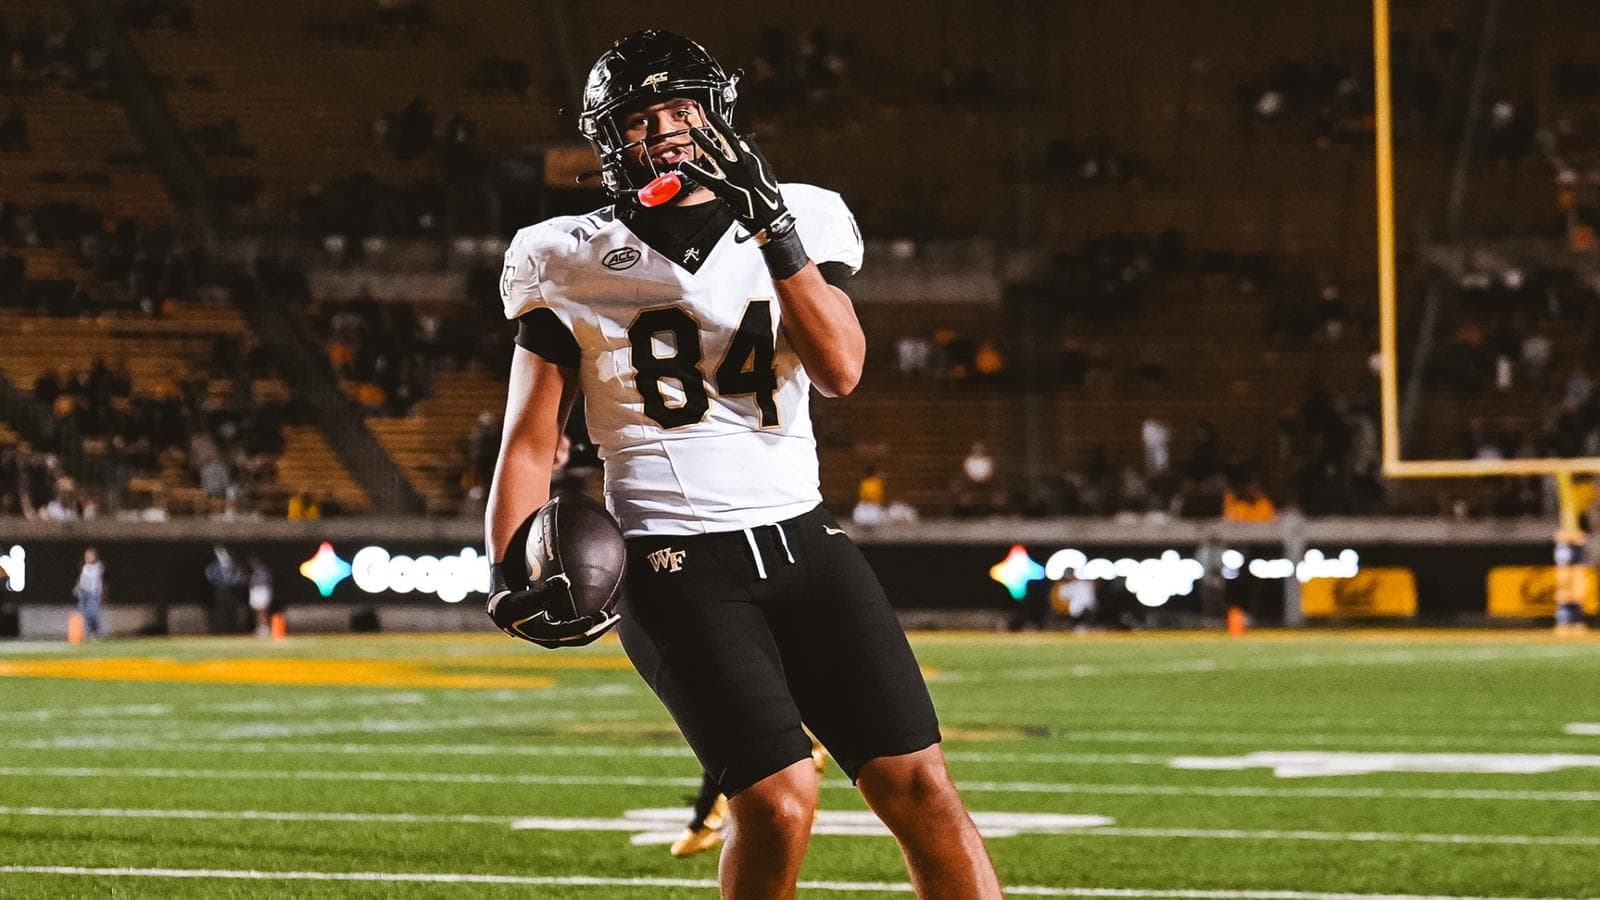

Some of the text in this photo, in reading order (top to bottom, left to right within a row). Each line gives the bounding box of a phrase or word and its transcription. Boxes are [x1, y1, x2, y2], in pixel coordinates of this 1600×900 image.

[641, 71, 669, 87] ACC
[608, 250, 636, 266] ACC
[625, 297, 782, 430] 84
[647, 547, 687, 573] WF
